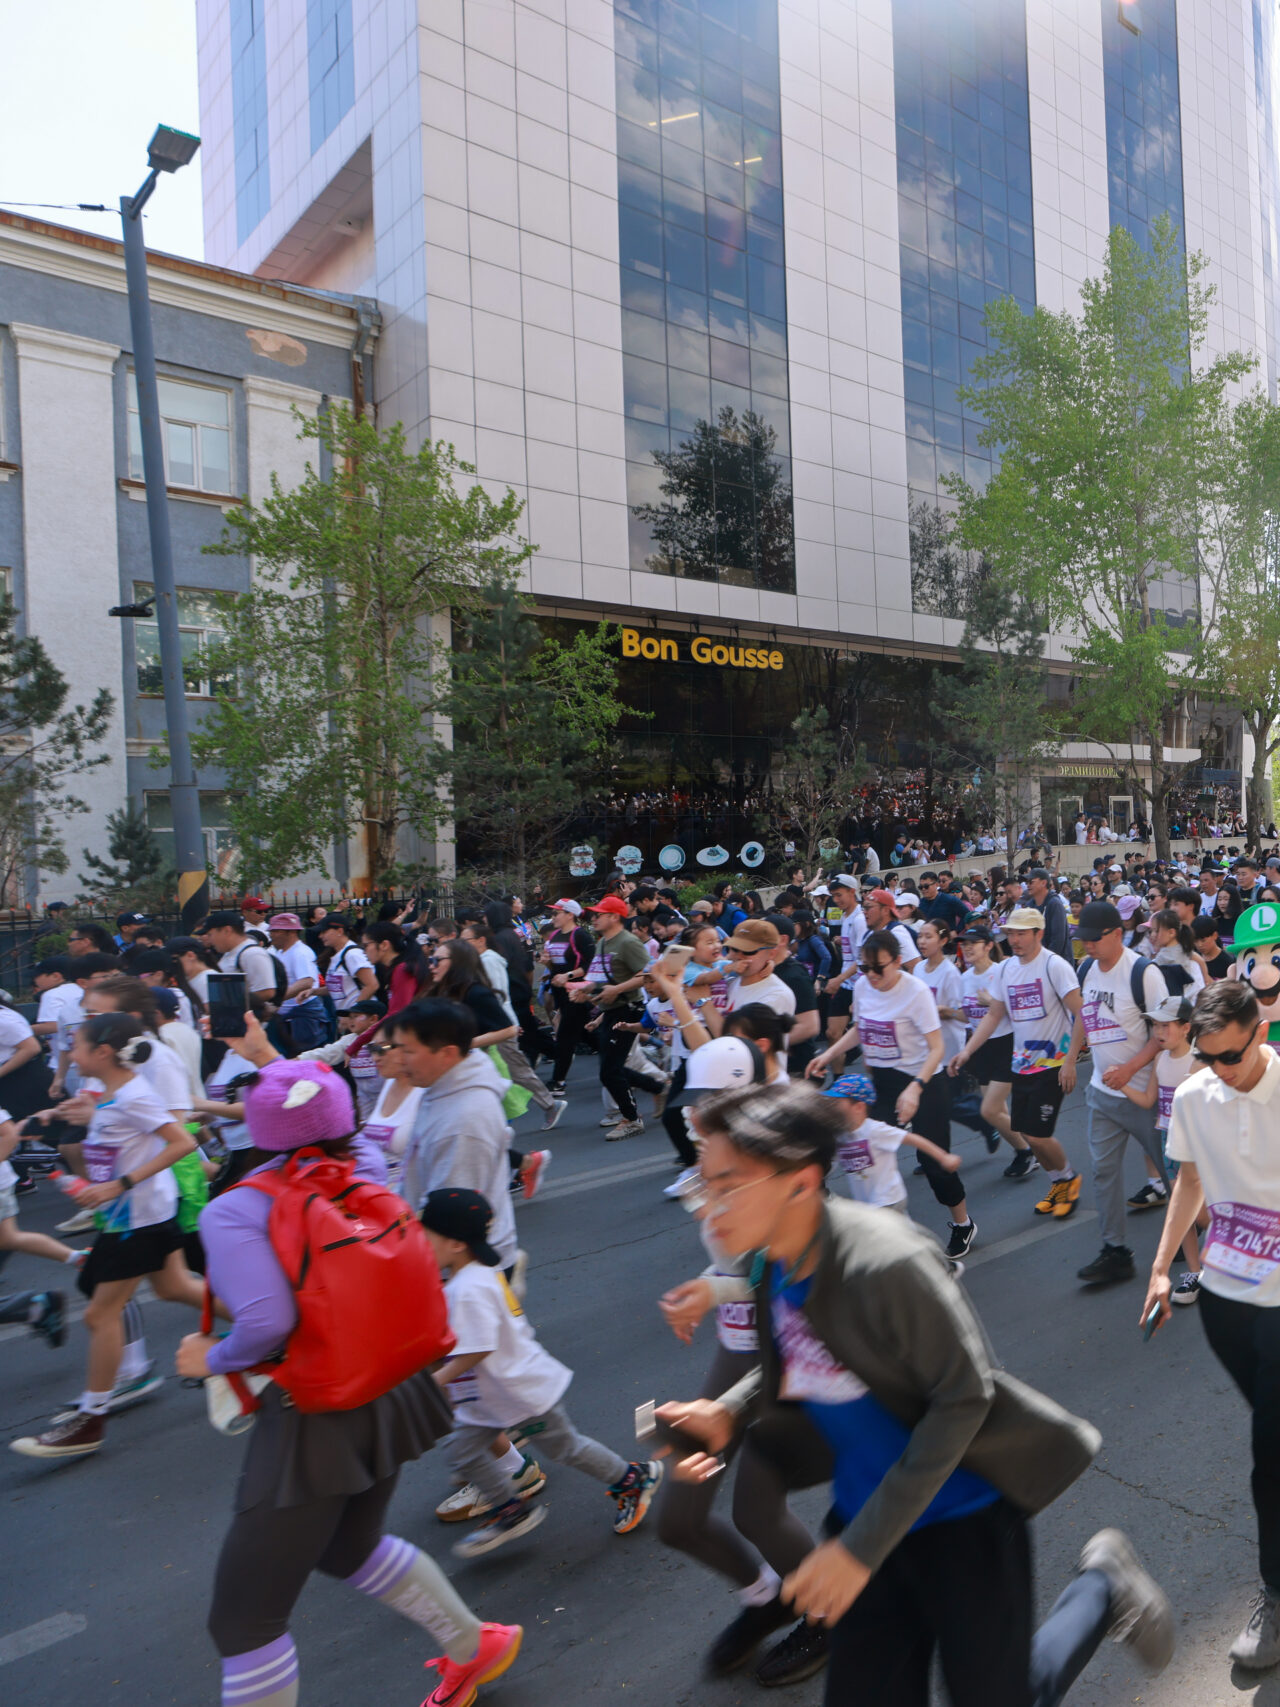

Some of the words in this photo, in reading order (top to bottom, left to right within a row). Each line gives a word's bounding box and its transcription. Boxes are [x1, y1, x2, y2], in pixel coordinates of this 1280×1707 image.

[622, 628, 678, 661] Bon
[691, 636, 784, 671] Gousse
[1258, 908, 1271, 929] L
